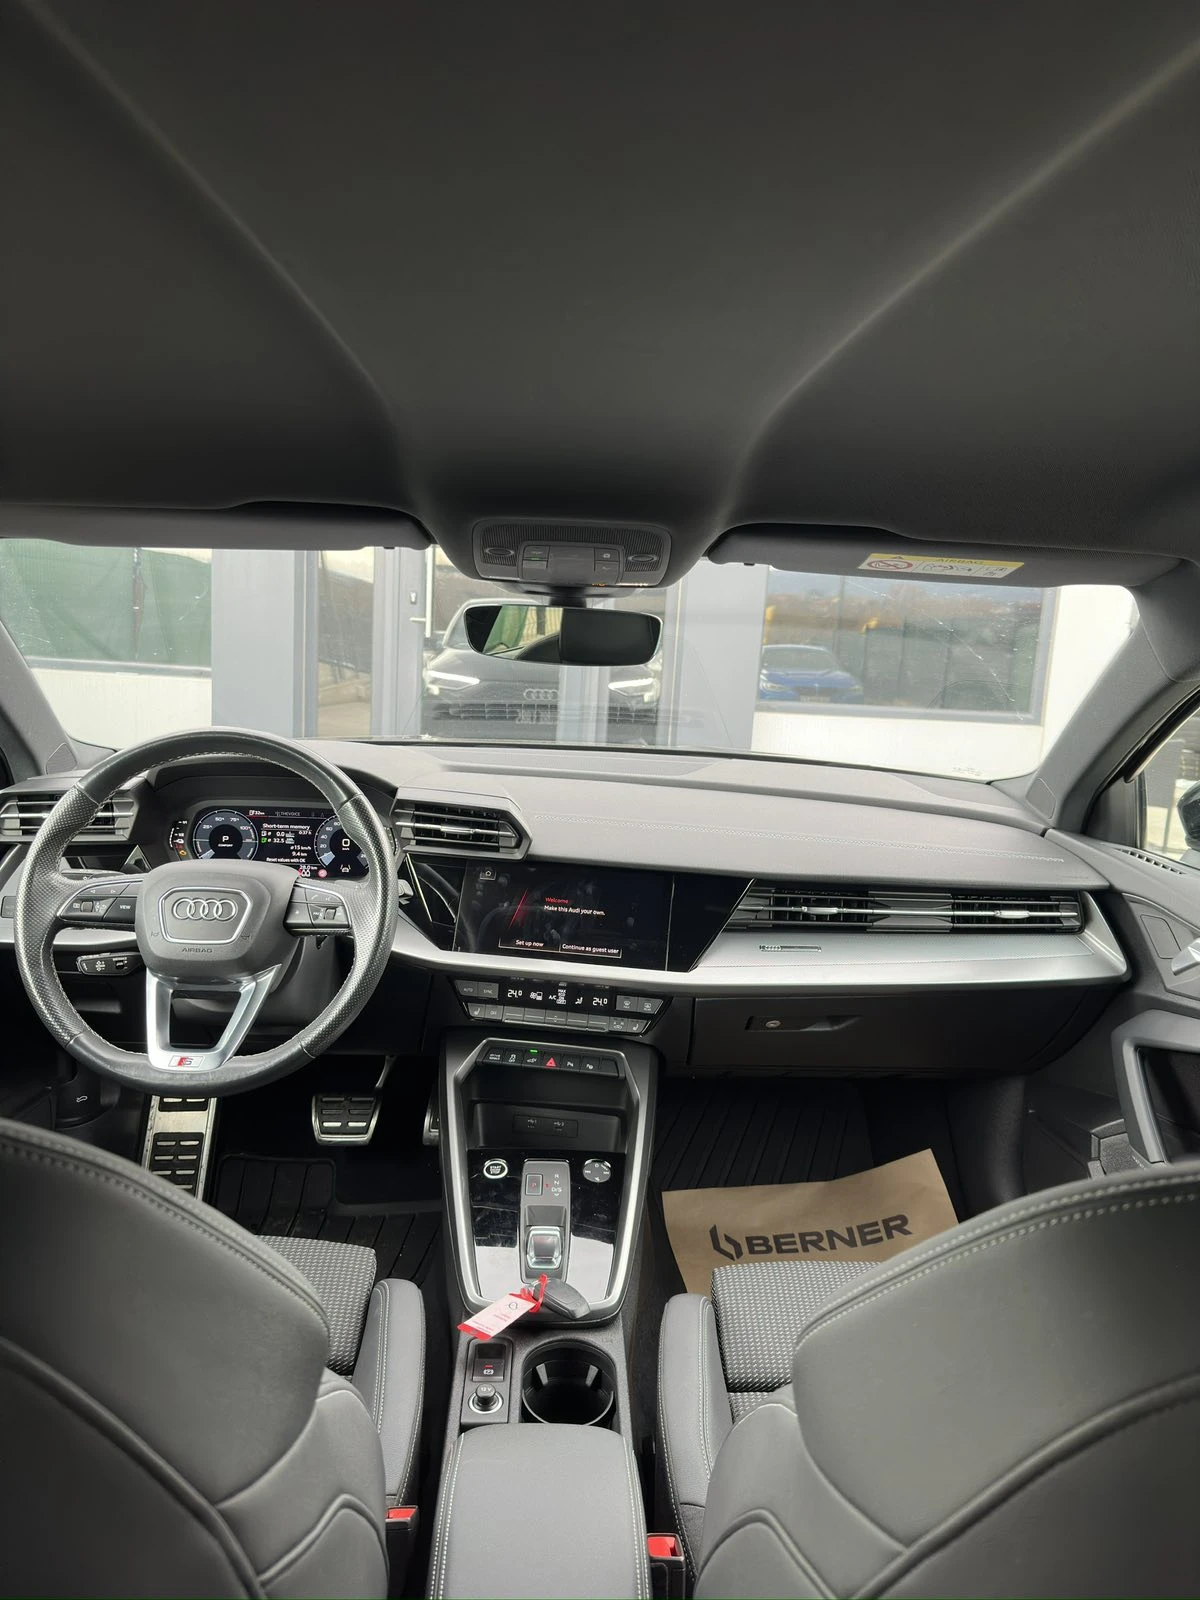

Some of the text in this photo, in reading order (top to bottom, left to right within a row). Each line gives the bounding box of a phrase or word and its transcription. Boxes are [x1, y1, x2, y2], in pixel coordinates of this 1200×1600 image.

[342, 838, 351, 847] 0
[562, 943, 585, 951] Continue
[745, 1213, 913, 1255] BERNER
